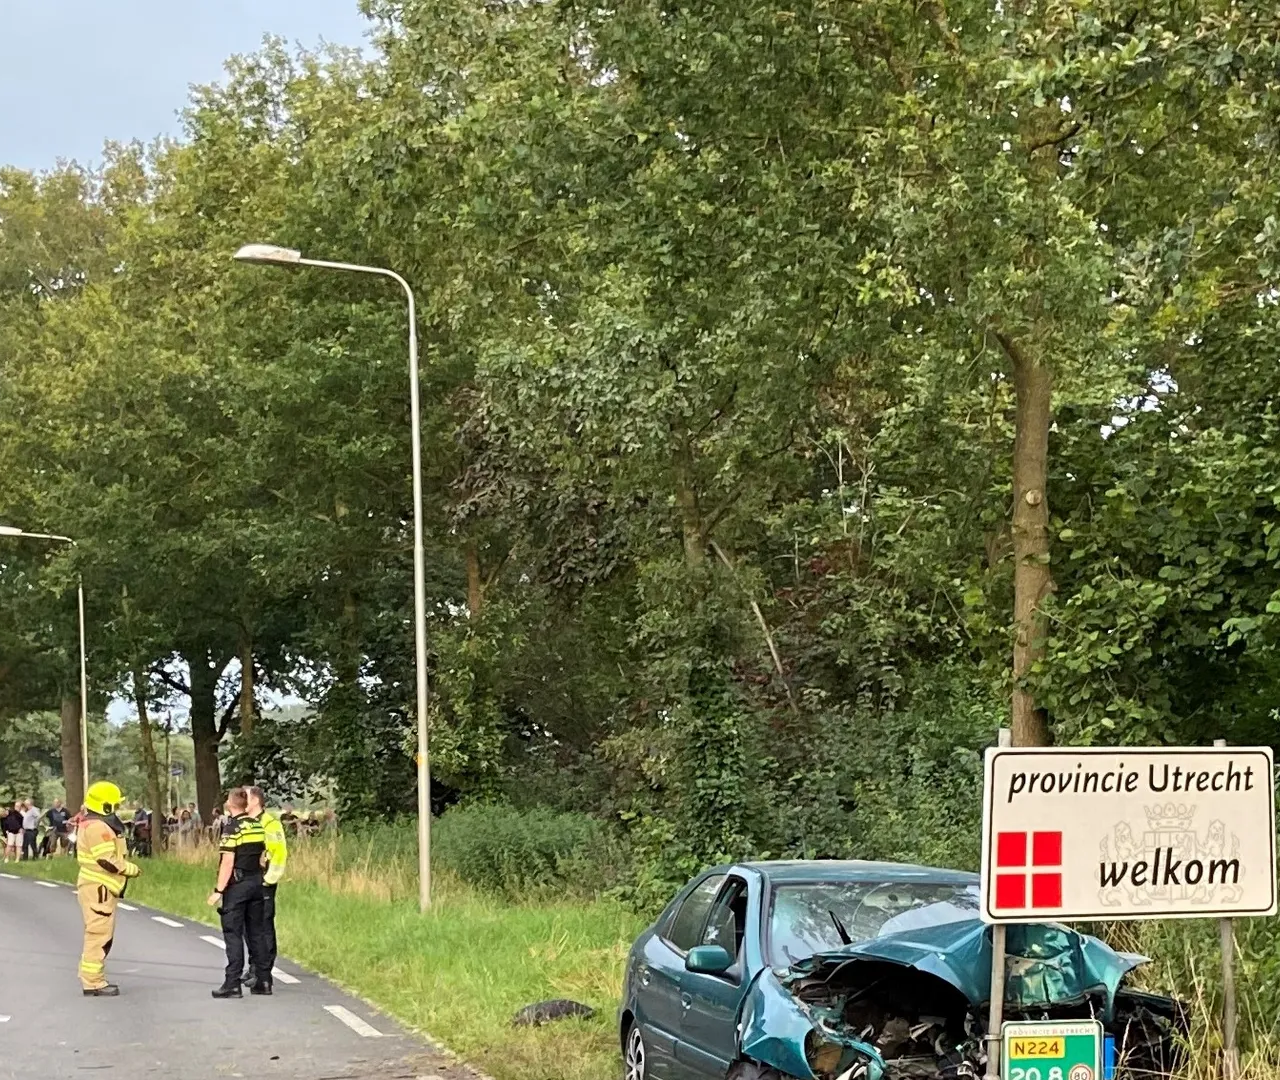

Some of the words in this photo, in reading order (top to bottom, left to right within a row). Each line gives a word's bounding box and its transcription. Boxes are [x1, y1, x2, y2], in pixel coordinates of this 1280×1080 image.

[1007, 762, 1139, 803] provincie
[1148, 761, 1254, 793] Utrecht
[1099, 847, 1240, 888] welkom
[1014, 1041, 1060, 1056] N224
[1073, 1071, 1088, 1080] 80
